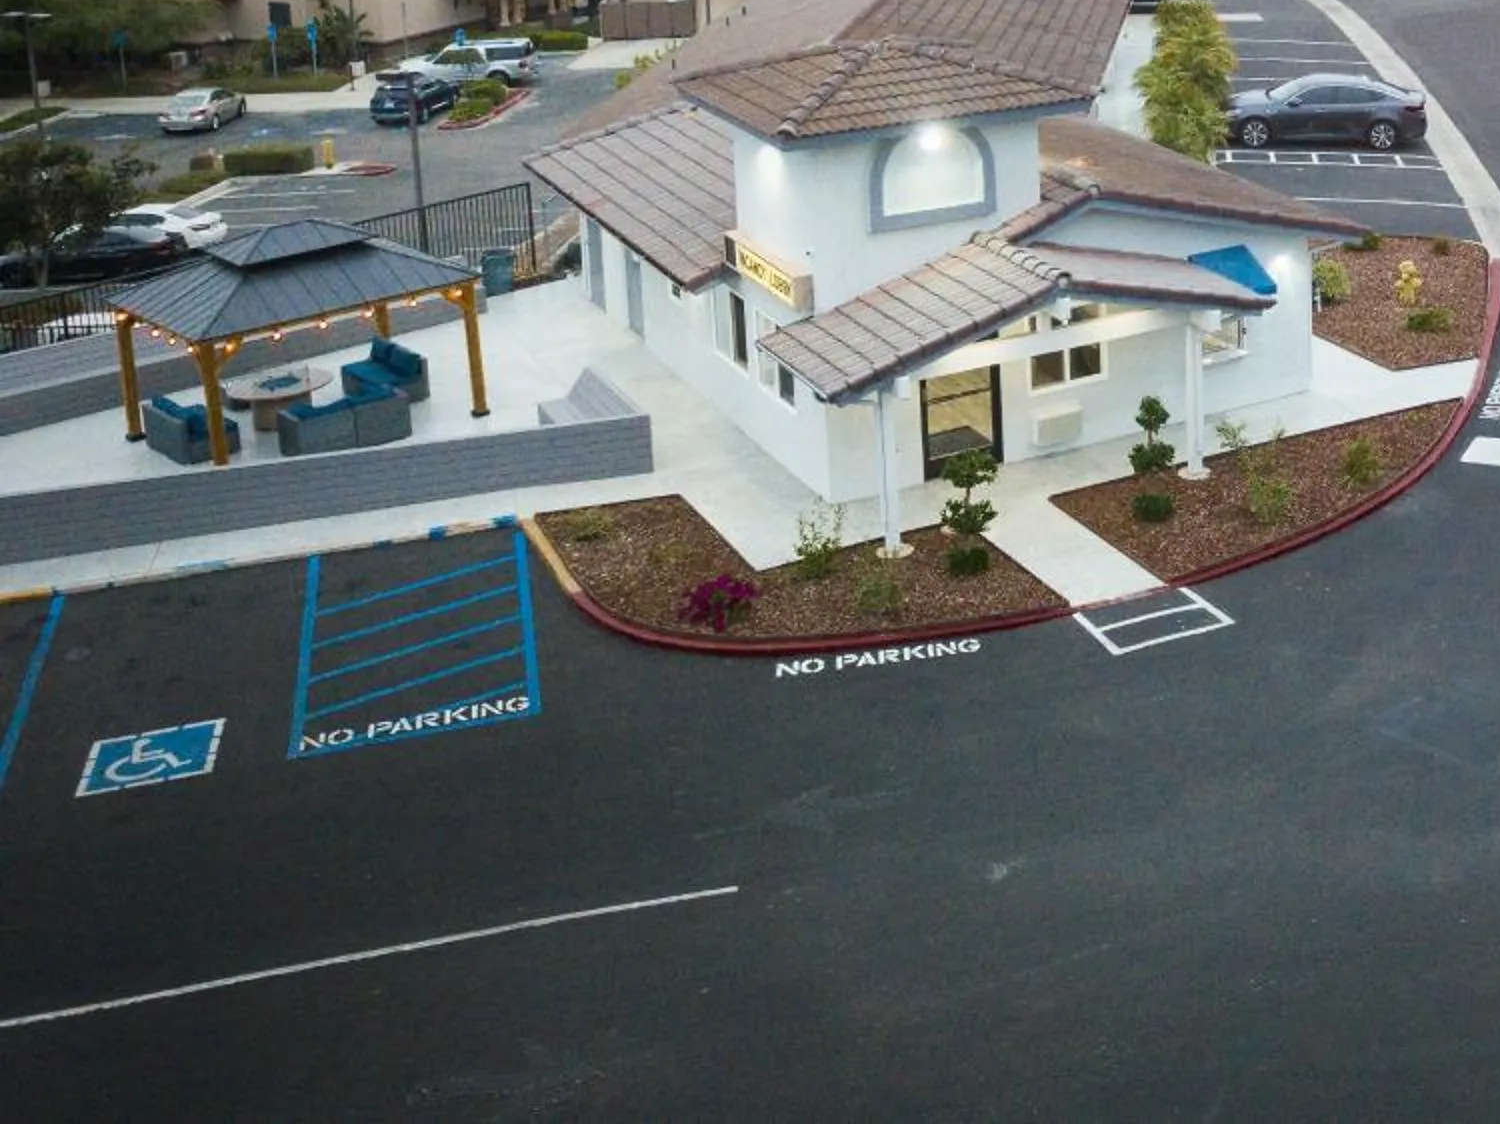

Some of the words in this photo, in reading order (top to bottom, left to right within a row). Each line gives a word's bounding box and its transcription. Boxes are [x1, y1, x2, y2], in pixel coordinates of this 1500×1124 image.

[774, 657, 825, 678] NO
[835, 638, 981, 671] PARKING
[300, 728, 354, 751] NO
[367, 695, 530, 739] PARKING
